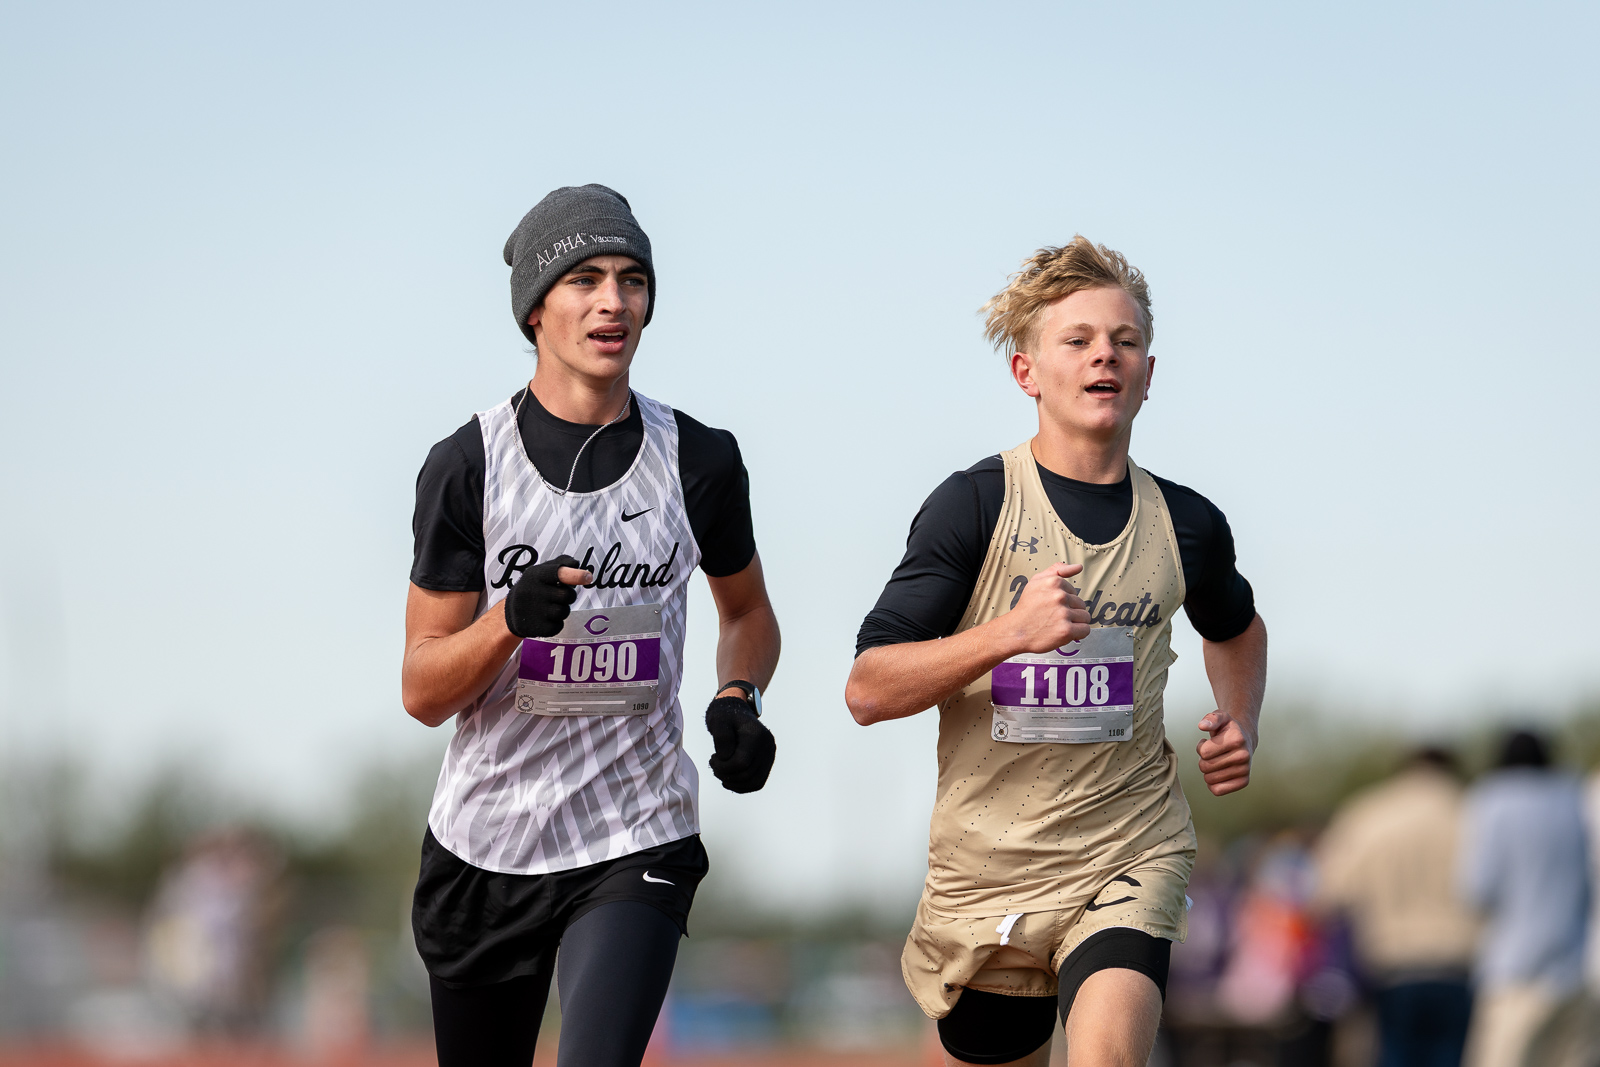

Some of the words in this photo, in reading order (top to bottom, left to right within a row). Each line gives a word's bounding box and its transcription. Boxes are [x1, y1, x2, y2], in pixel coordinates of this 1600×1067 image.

[590, 234, 627, 244] Vaccines
[547, 641, 638, 682] 1090
[1020, 665, 1110, 706] 1108
[632, 702, 650, 711] 1090
[1108, 728, 1125, 737] 1108
